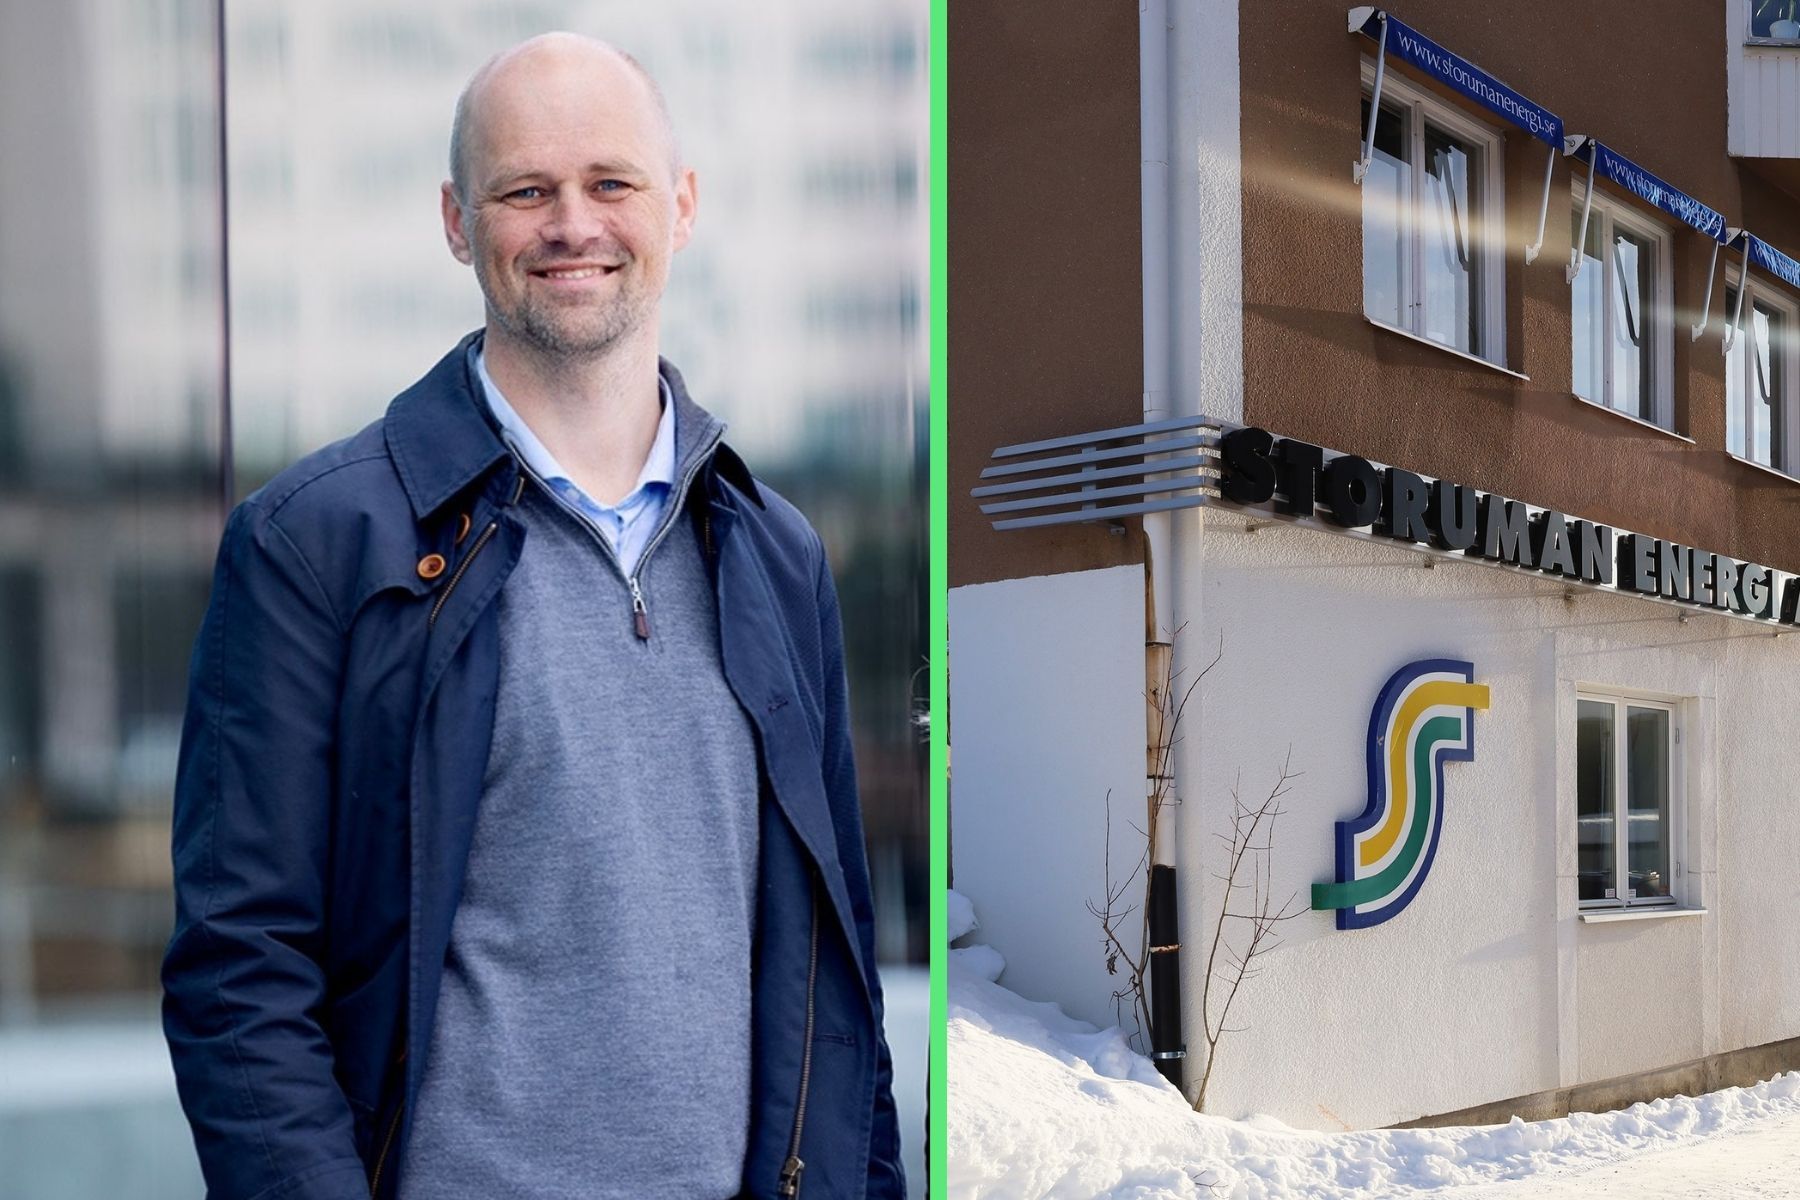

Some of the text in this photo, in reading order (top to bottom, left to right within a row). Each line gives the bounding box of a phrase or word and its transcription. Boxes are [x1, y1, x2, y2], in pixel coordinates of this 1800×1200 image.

[1398, 31, 1555, 137] www.storumanenergi.se
[1221, 427, 1781, 619] STORUMAN ENERGI
